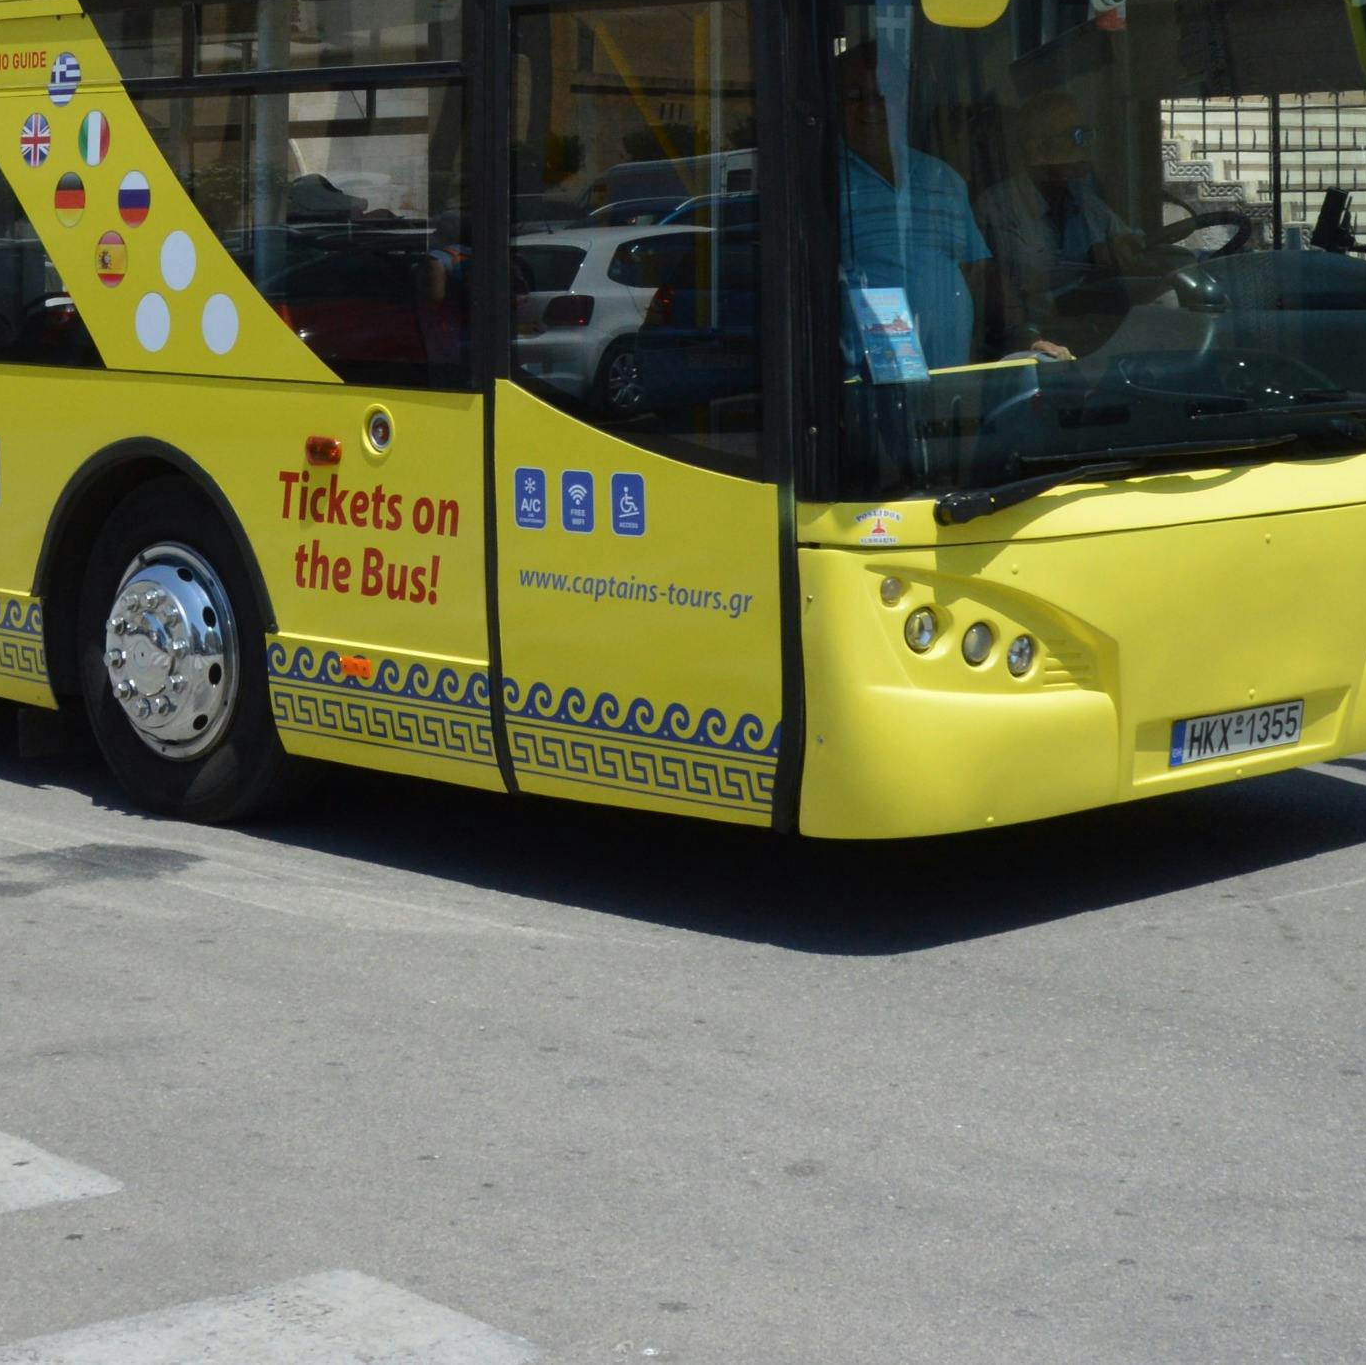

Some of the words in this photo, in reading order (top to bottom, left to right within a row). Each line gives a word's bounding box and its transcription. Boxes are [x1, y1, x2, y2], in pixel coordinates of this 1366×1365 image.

[12, 50, 47, 69] GUIDE
[279, 470, 403, 532] Tickets
[412, 497, 460, 537] on
[520, 498, 541, 513] A/C
[294, 539, 352, 593] the
[360, 547, 441, 605] Bus!
[519, 569, 753, 619] www.captains-tours.gr
